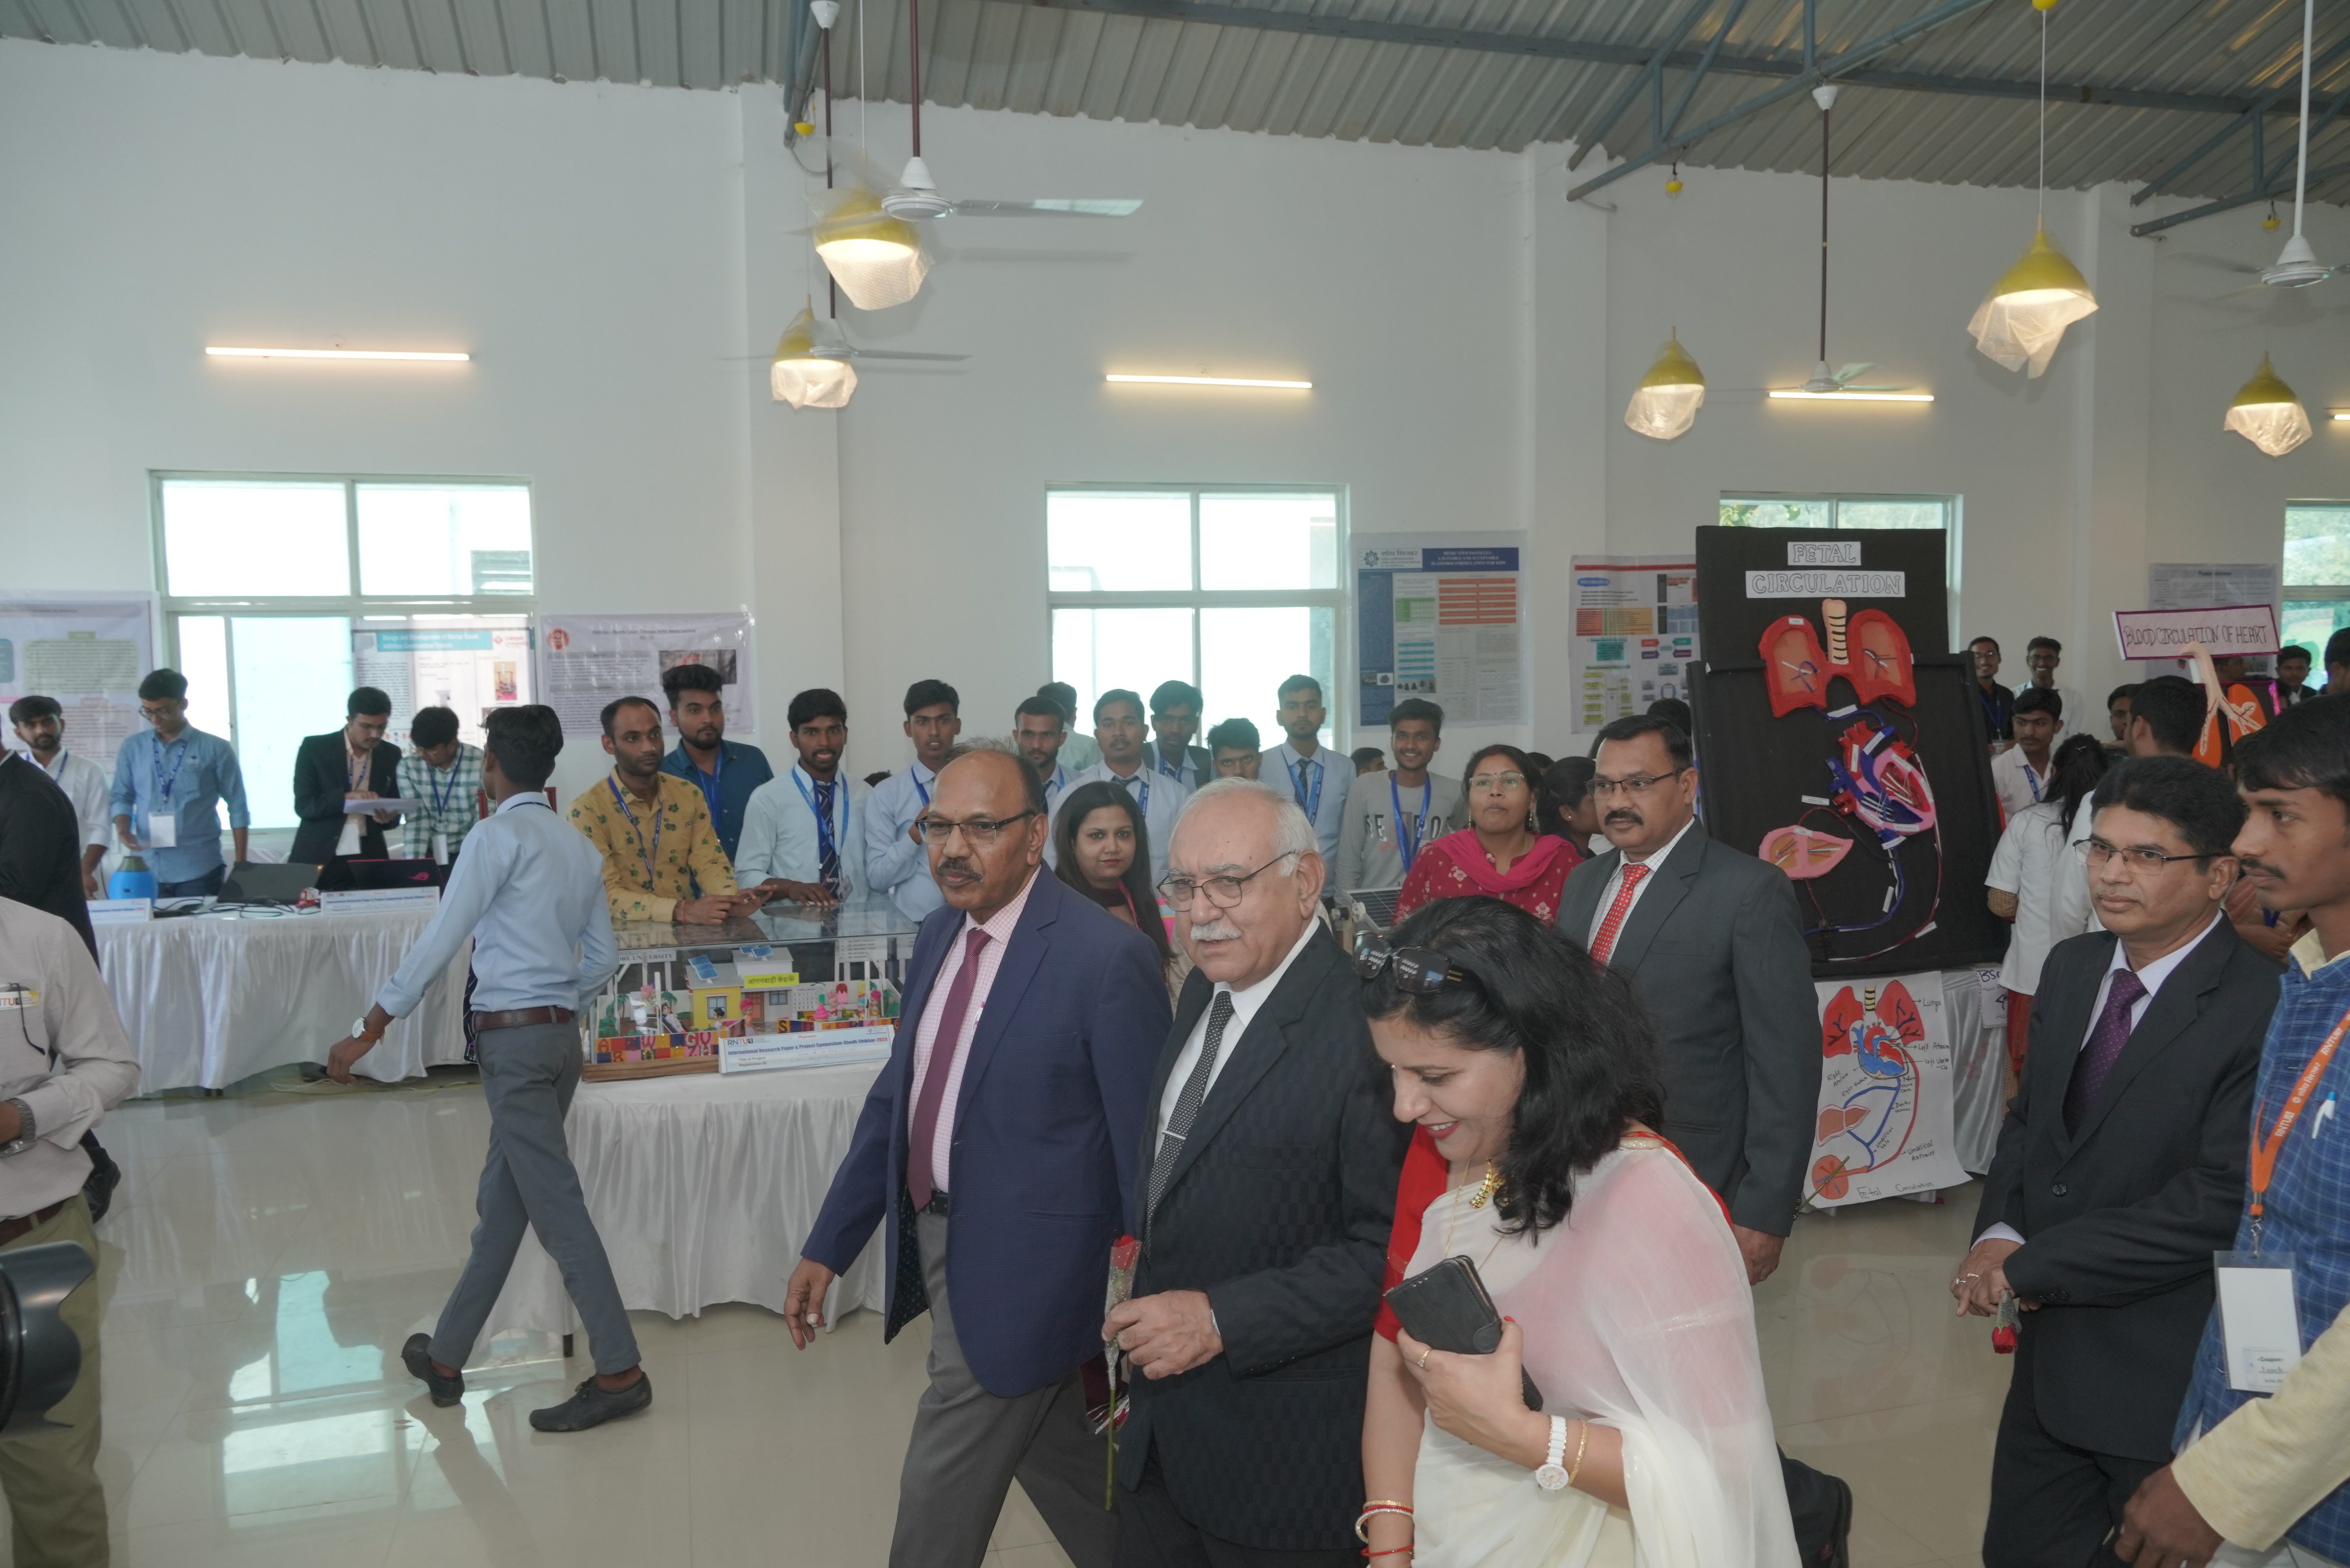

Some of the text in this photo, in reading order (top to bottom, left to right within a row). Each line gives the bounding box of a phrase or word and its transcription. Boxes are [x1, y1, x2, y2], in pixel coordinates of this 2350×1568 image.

[1793, 544, 1856, 563] FETAL
[1752, 573, 1900, 594] CIRCULATION
[2124, 625, 2267, 647] BLOOD CIRCULATION OF HEART
[1923, 997, 1941, 1012] Lungs
[1857, 1186, 1882, 1199] Fetal
